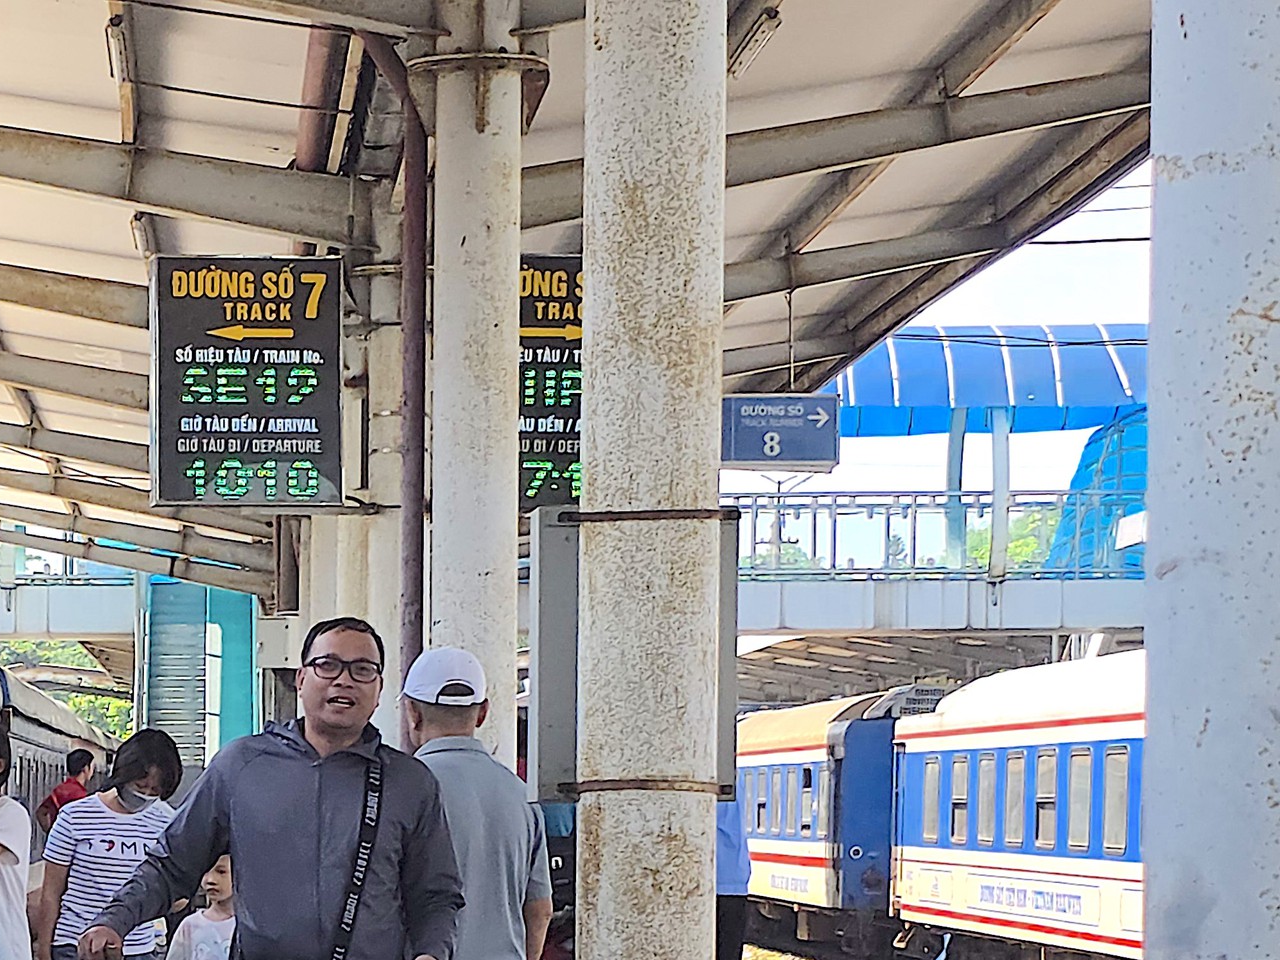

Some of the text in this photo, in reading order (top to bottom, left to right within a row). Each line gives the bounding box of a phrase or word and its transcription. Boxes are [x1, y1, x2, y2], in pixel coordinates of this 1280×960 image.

[172, 263, 327, 319] ĐƯỜNG SỐ 7
[223, 302, 292, 321] TRACK
[262, 350, 300, 364] TRAIN
[268, 418, 319, 433] ARRIVAL
[252, 439, 323, 453] DEPARTURE
[763, 432, 780, 457] 8
